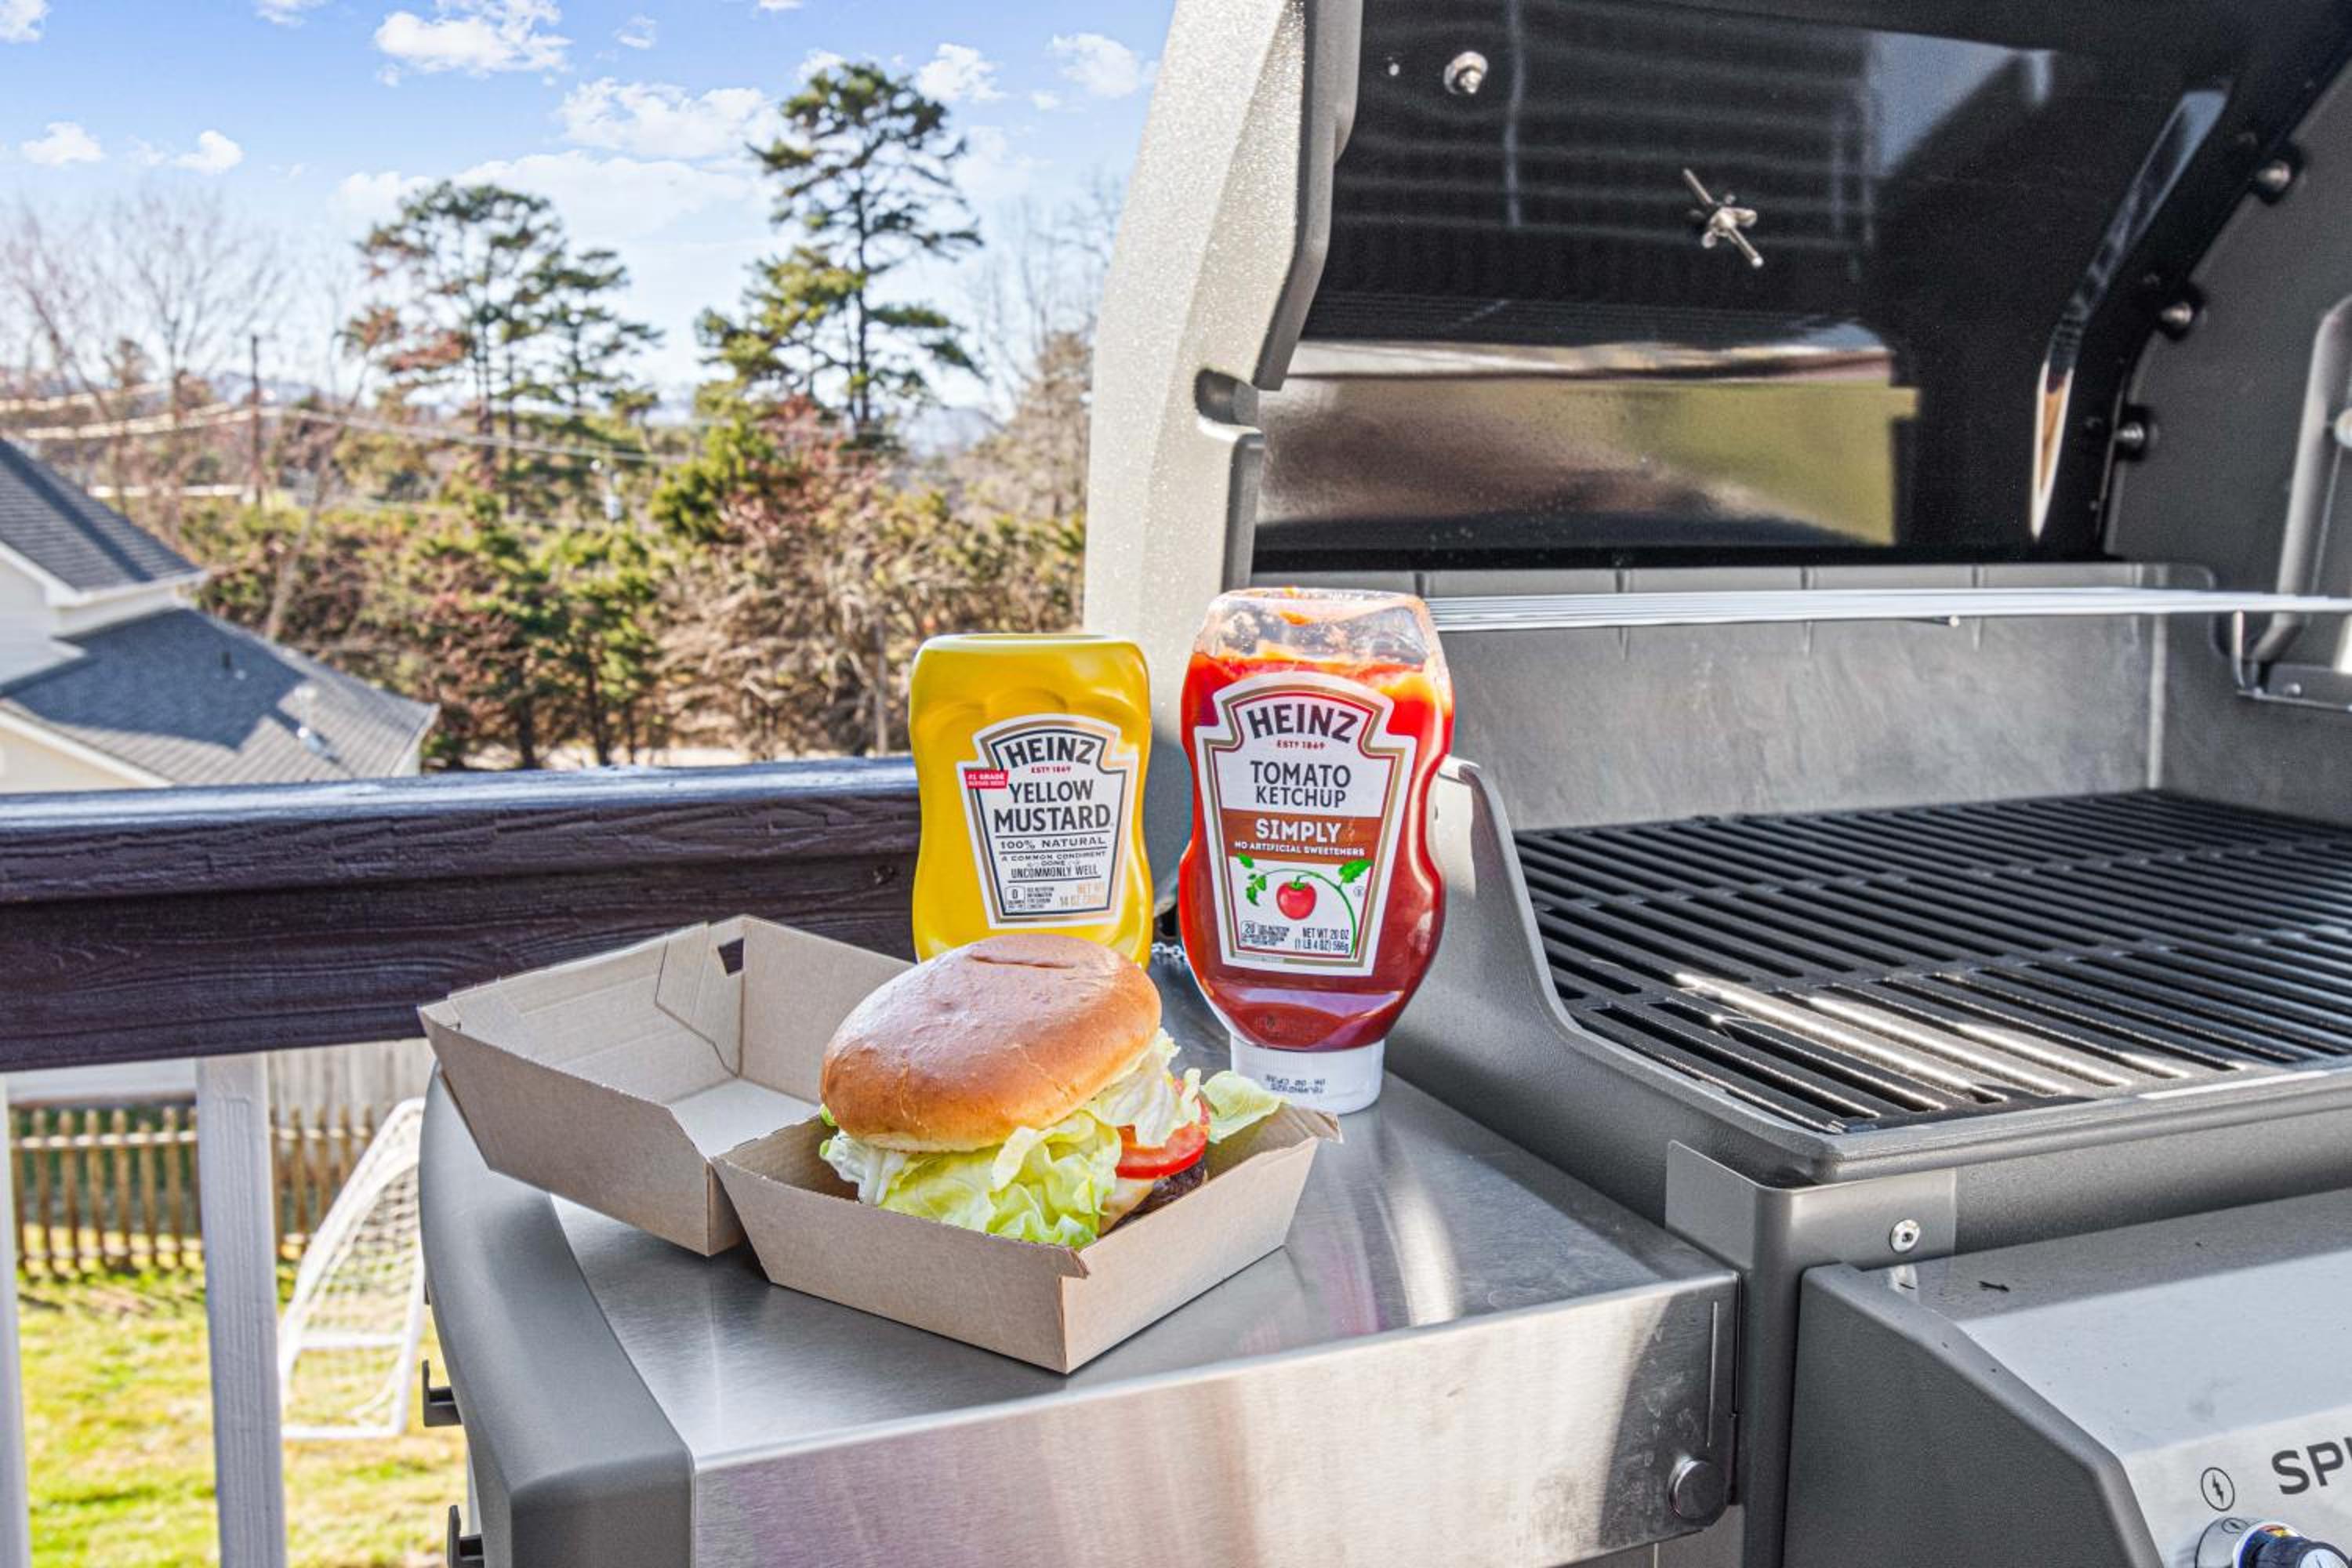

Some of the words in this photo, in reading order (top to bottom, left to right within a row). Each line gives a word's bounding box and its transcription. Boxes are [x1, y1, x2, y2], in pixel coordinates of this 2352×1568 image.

[1247, 704, 1359, 743] HEINZ
[1004, 737, 1096, 768] HEINZ
[1302, 741, 1325, 750] 1869
[1250, 760, 1351, 788] TOMATO
[1009, 779, 1094, 804] YELLOW
[1256, 786, 1346, 808] KETCHUP
[995, 804, 1110, 833] MUSTARD
[1256, 818, 1341, 844] SIMPLY
[1000, 840, 1036, 850] 100%
[1042, 837, 1105, 848] NATURAL
[1234, 840, 1247, 849] NO
[1250, 843, 1301, 853] ARTIFICIAL
[1304, 847, 1364, 856] SWEETENERS
[1056, 851, 1106, 859] CONDIMENT
[1011, 866, 1072, 878] UNCOMMONLY
[1075, 865, 1098, 876] WELL
[1302, 927, 1315, 938] NET
[1316, 928, 1328, 938] WT
[1330, 929, 1339, 939] 20
[1340, 929, 1349, 939] OZ
[1303, 938, 1312, 949] LB
[1313, 940, 1318, 949] 4
[2271, 1436, 2352, 1494] SP
